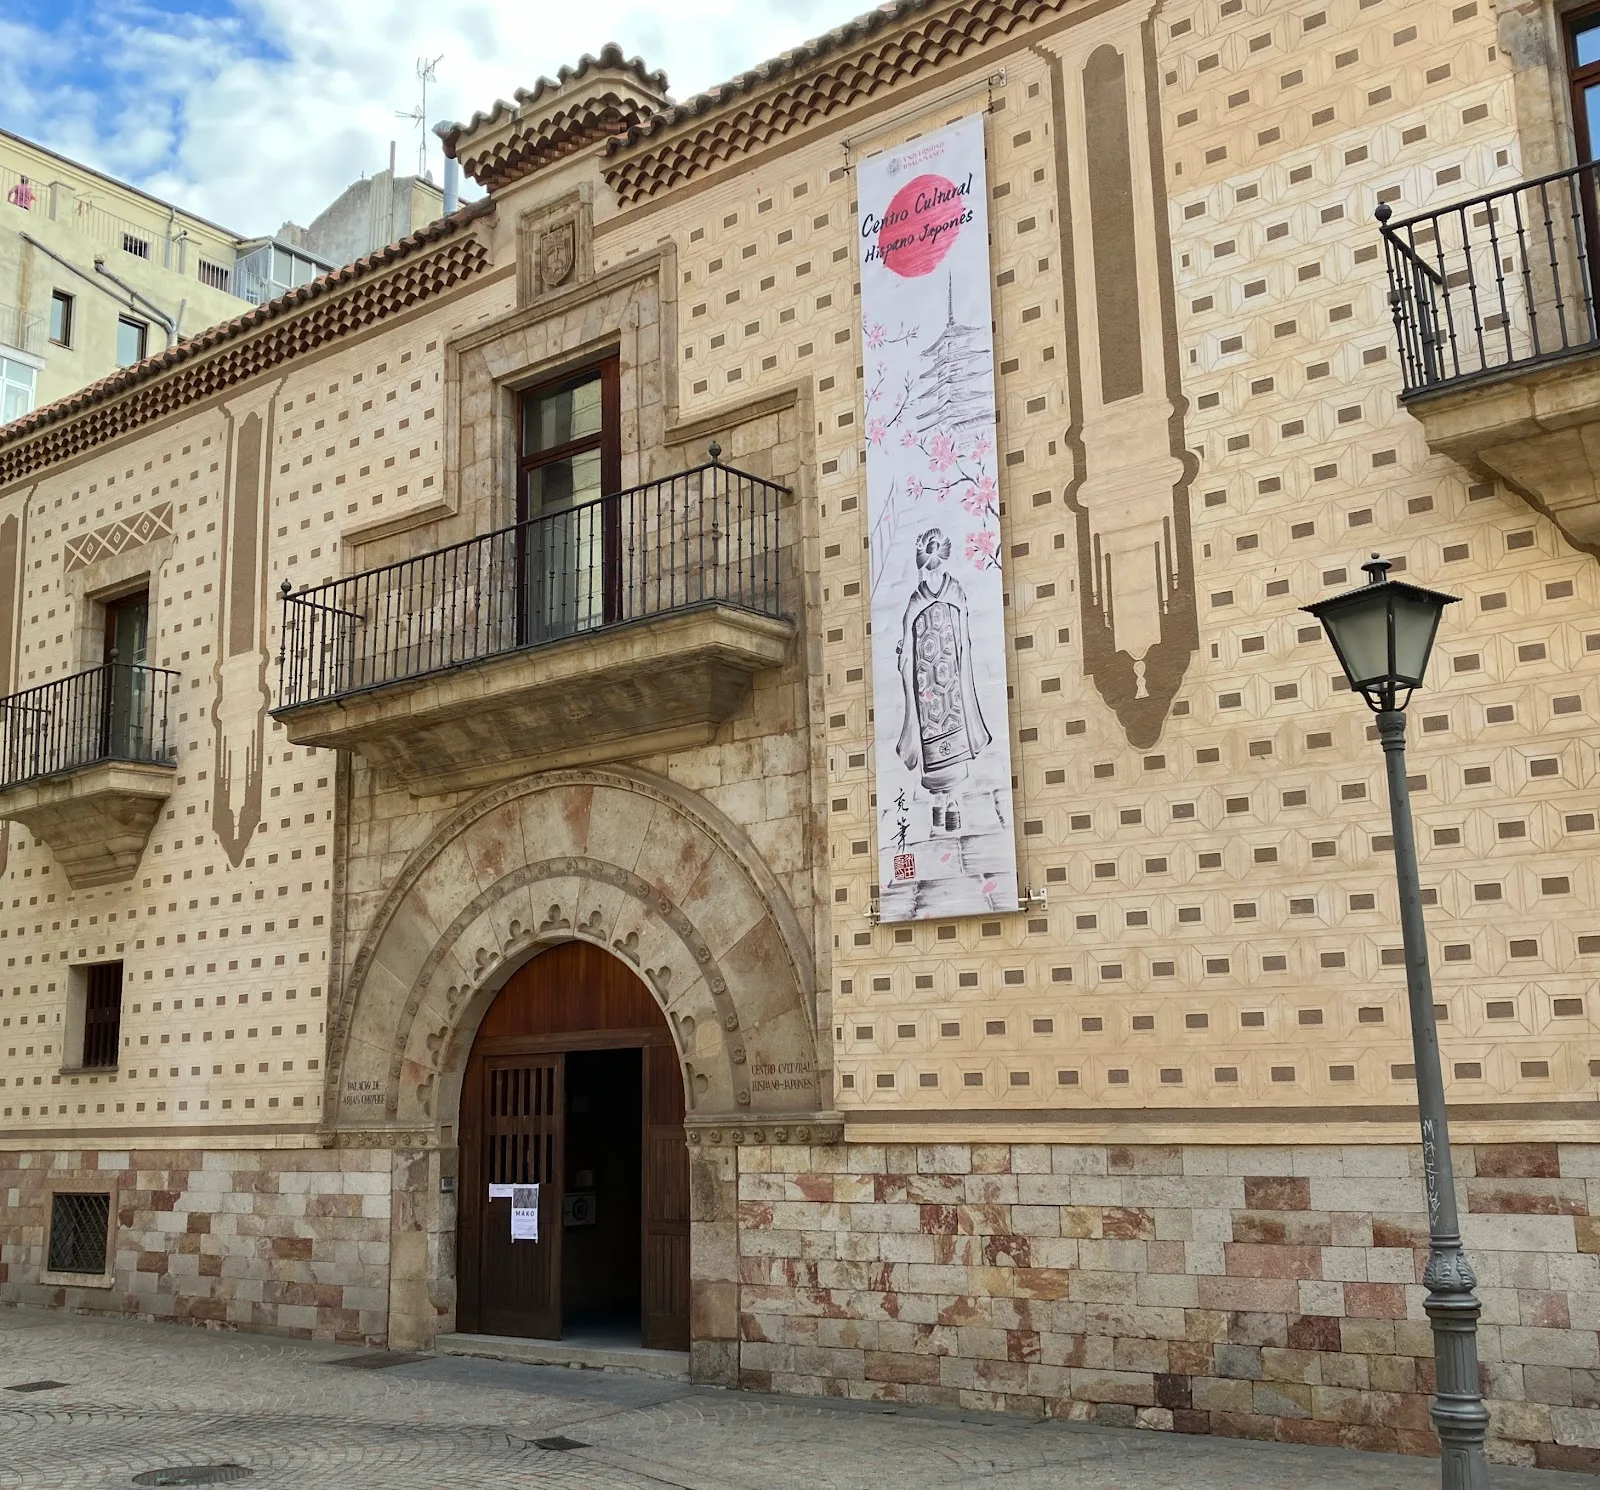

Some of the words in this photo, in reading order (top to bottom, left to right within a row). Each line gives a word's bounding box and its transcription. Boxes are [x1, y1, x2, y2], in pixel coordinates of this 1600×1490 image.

[861, 209, 909, 238] Centro
[915, 172, 973, 214] Cultural
[864, 234, 915, 264] Hispano
[918, 207, 974, 244] Japonés
[751, 1064, 776, 1076] CENTRO
